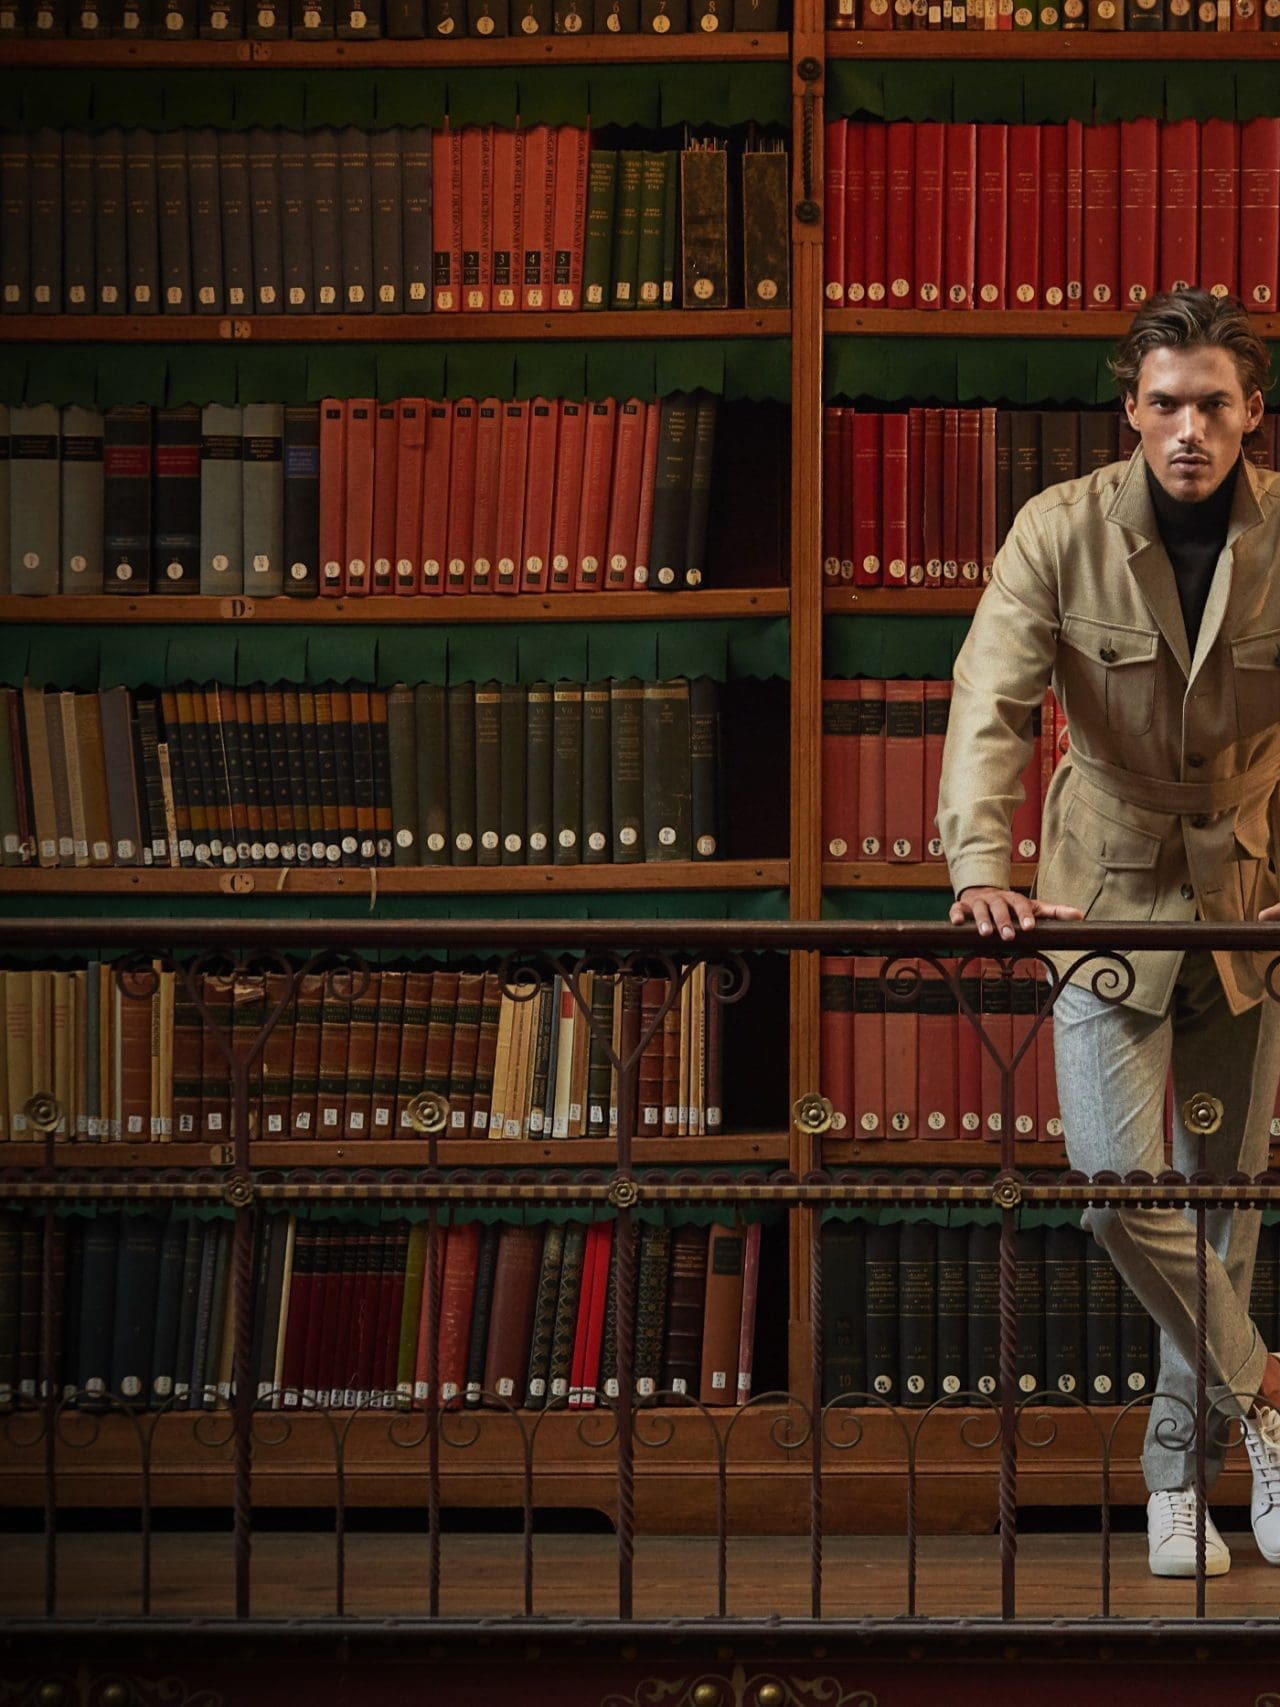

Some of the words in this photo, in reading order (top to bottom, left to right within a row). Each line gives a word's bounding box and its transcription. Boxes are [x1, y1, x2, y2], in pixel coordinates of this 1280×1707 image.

[451, 194, 460, 249] DICTIONARY
[481, 194, 490, 249] DICTIONARY
[512, 194, 522, 249] DICTIONARY
[544, 194, 552, 249] DICTIONARY
[575, 194, 584, 249] DICTIONARY
[439, 254, 445, 265] 1
[468, 254, 474, 265] 2
[499, 254, 505, 265] 3
[529, 254, 536, 265] 4
[559, 254, 565, 265] 5
[232, 599, 246, 617] D
[230, 874, 243, 892] C
